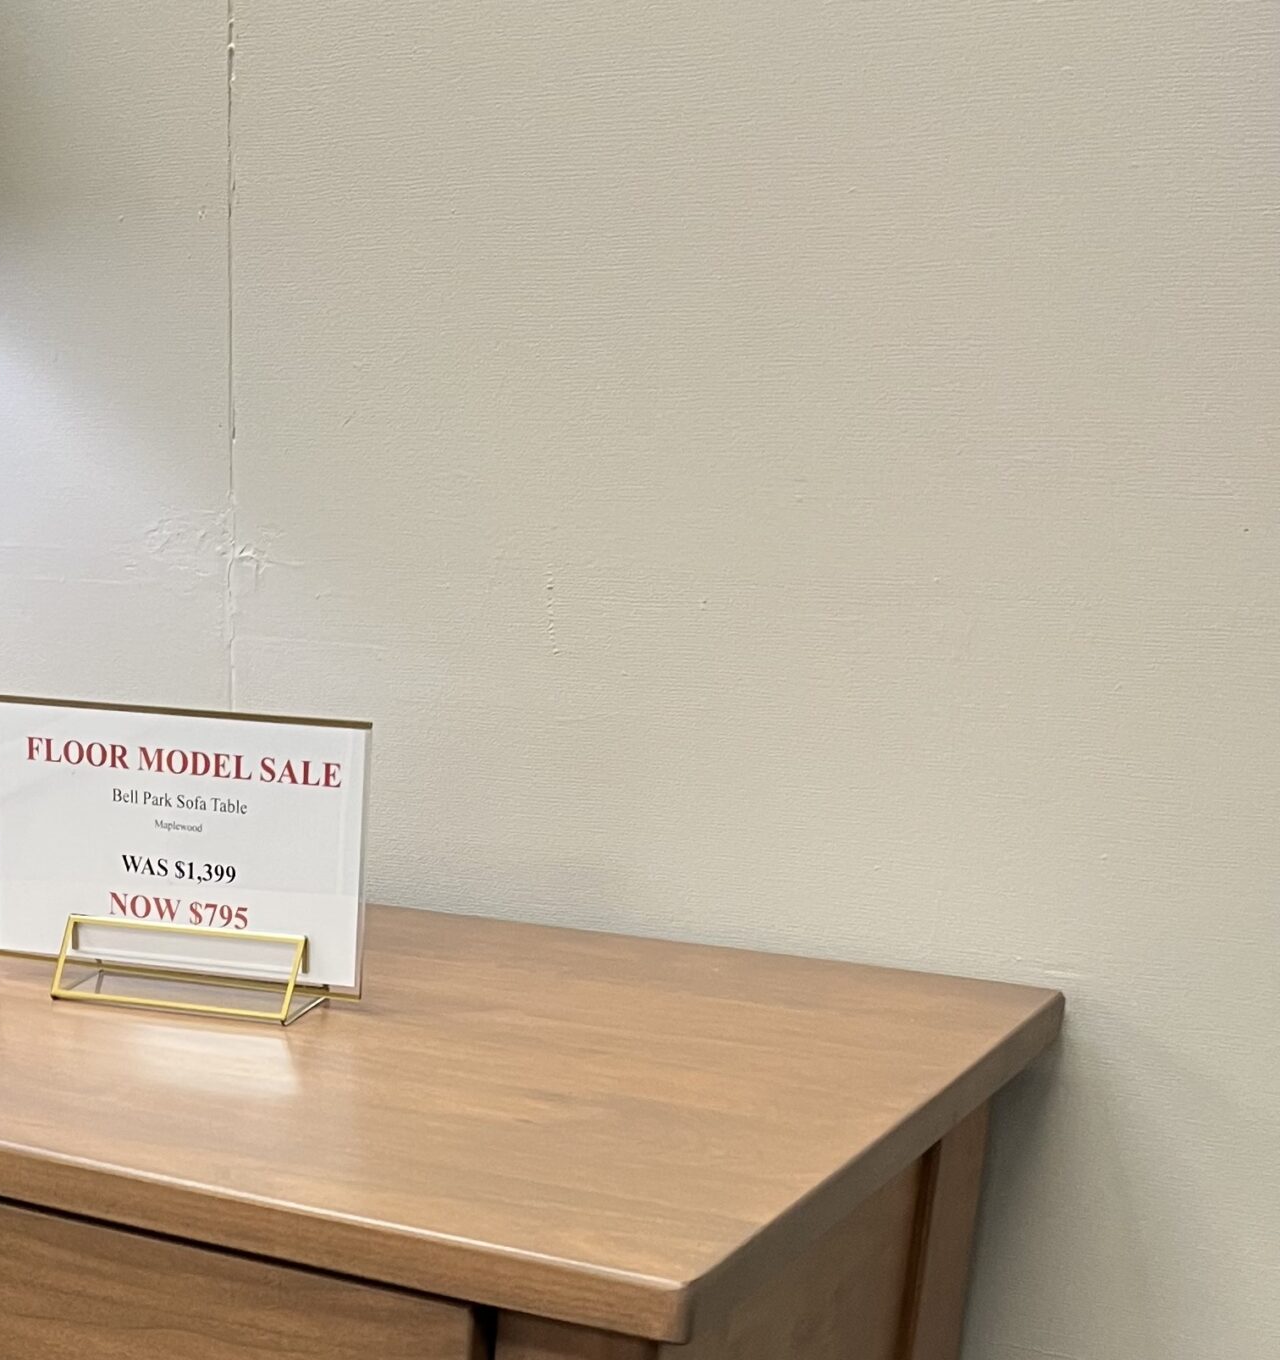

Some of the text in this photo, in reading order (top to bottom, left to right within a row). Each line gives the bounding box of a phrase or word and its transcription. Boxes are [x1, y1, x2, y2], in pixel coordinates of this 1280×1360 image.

[27, 736, 342, 788] FLOOR MODEL SALE
[112, 788, 248, 814] Bell Park Sofa Table
[154, 820, 202, 833] Maplewood
[122, 855, 237, 884] WAS $1,399
[109, 892, 249, 930] NOW $795
